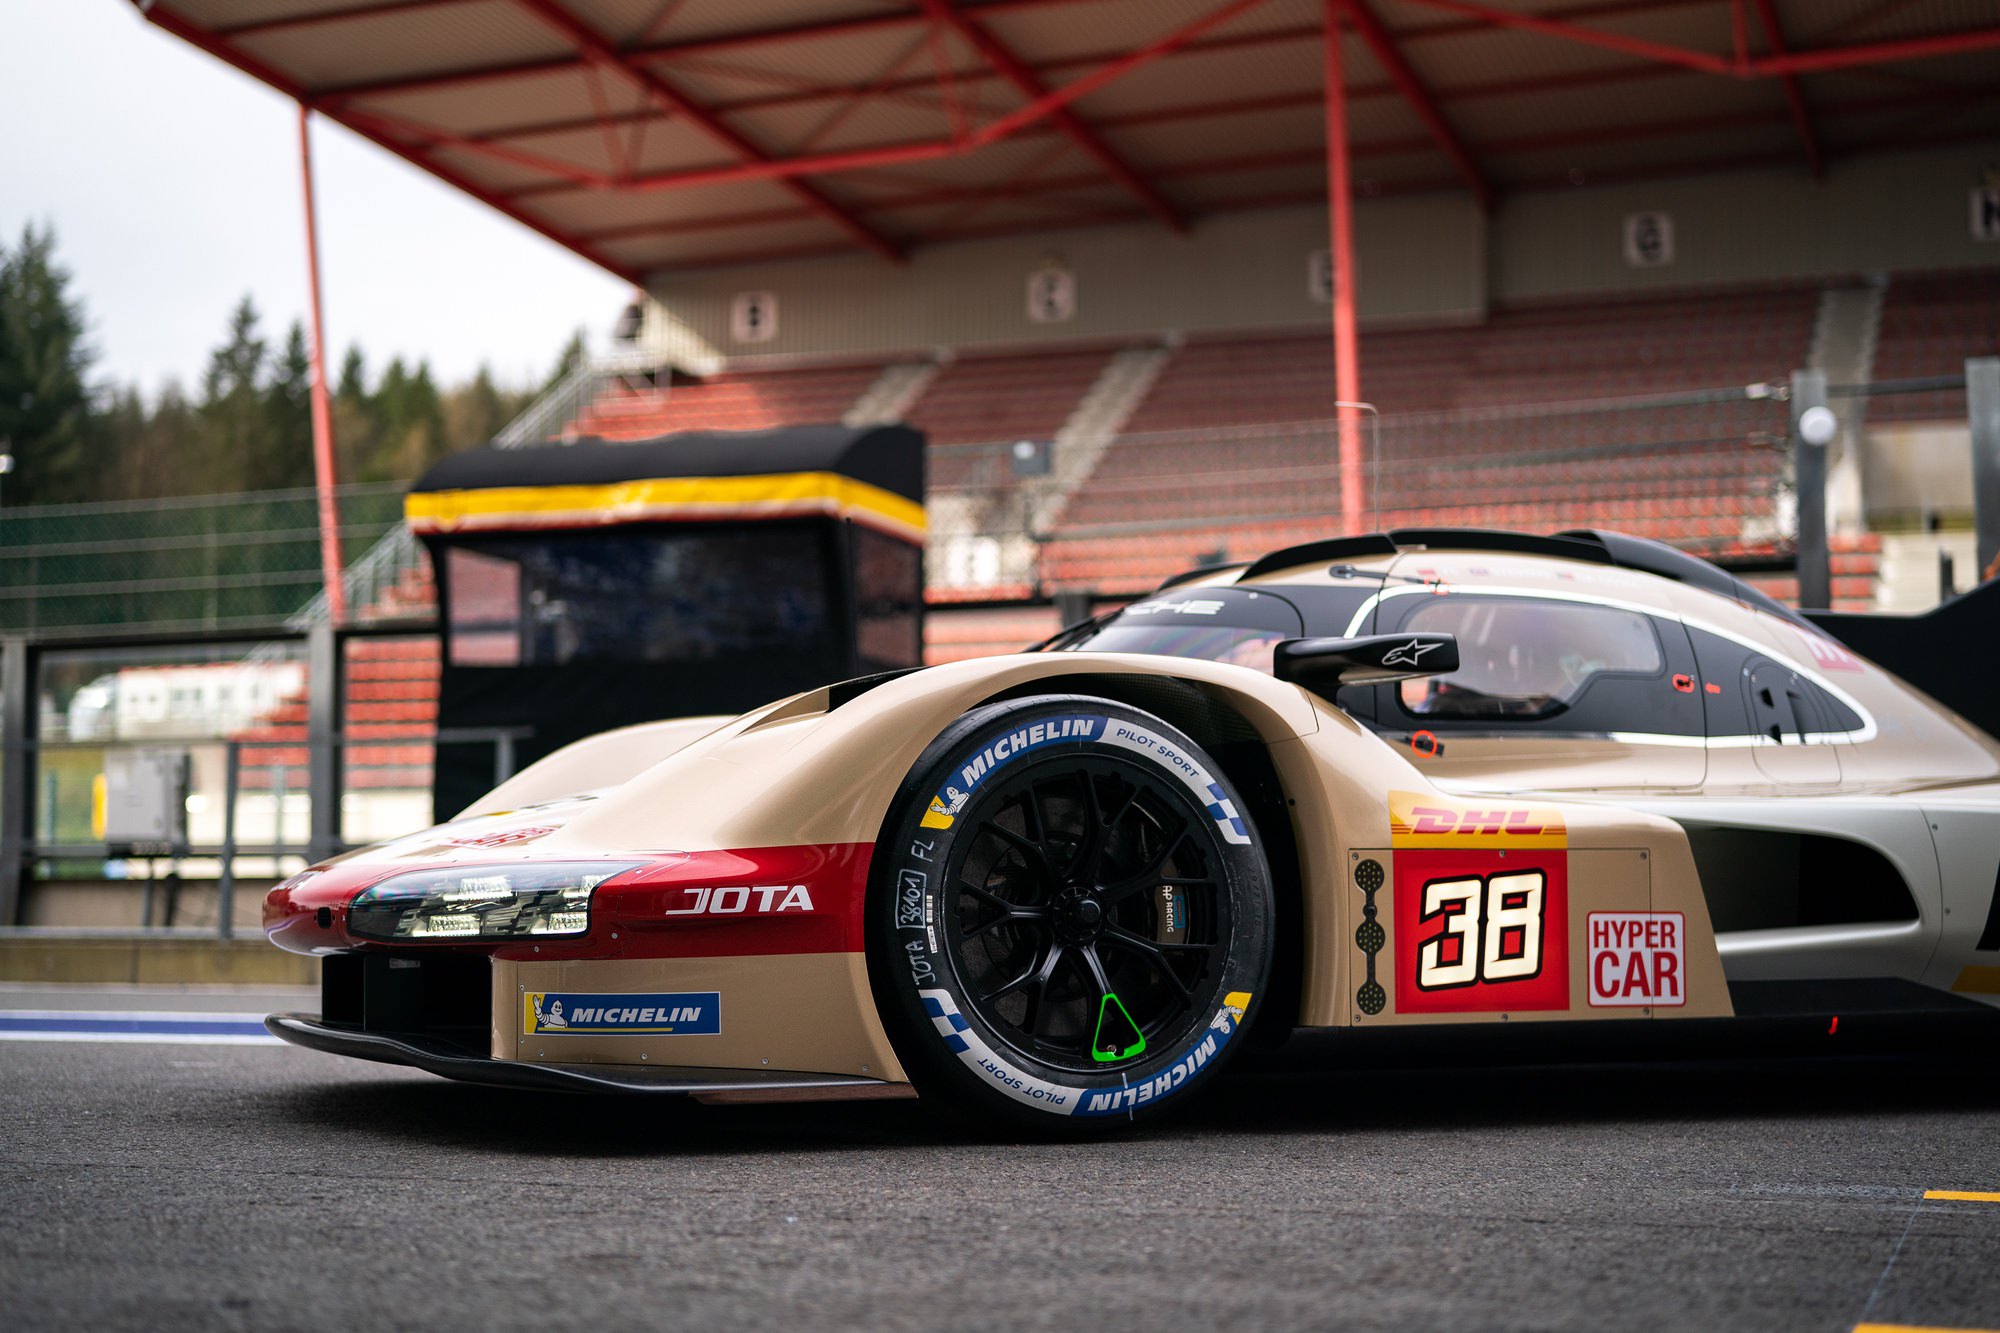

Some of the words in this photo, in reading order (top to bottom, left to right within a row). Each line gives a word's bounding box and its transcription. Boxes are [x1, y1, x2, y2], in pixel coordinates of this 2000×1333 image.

[961, 719, 1094, 788] MICHELIN
[1116, 728, 1157, 748] PILOT
[1157, 745, 1200, 777] SPORT
[1411, 806, 1544, 835] DHL
[911, 839, 935, 863] FL
[665, 885, 814, 915] JOTA
[900, 876, 923, 925] 38101
[1162, 885, 1173, 901] AP
[1416, 867, 1547, 992] 38
[1593, 921, 1676, 949] HYPER
[905, 940, 936, 986] JOTA
[1594, 951, 1679, 998] CAR
[571, 1007, 702, 1024] MICHELIN
[977, 1058, 1024, 1090] SPORT
[1088, 1034, 1217, 1112] MICHELIN
[1022, 1086, 1067, 1106] PILOT
